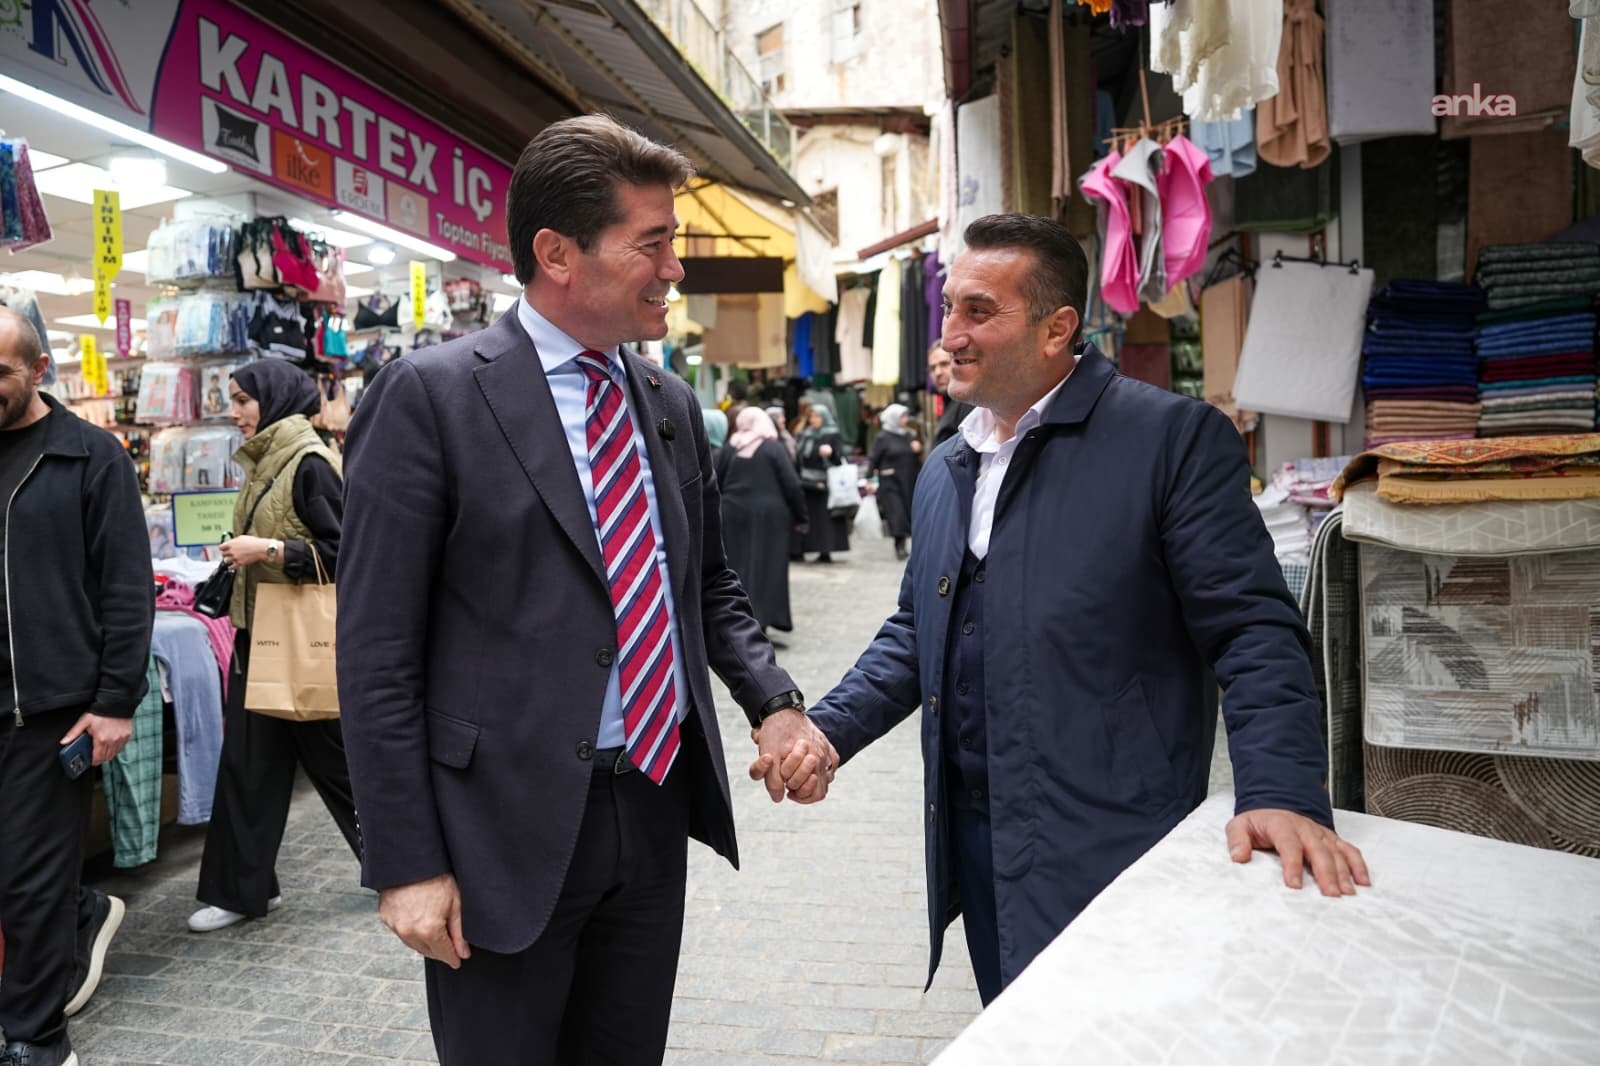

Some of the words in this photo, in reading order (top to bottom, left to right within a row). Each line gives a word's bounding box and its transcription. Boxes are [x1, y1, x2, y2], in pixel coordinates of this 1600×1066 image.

[198, 16, 438, 194] KARTEX
[453, 147, 493, 221] İÇ
[287, 152, 321, 188] ilke
[436, 211, 480, 250] Toptan
[309, 640, 330, 648] LOVE
